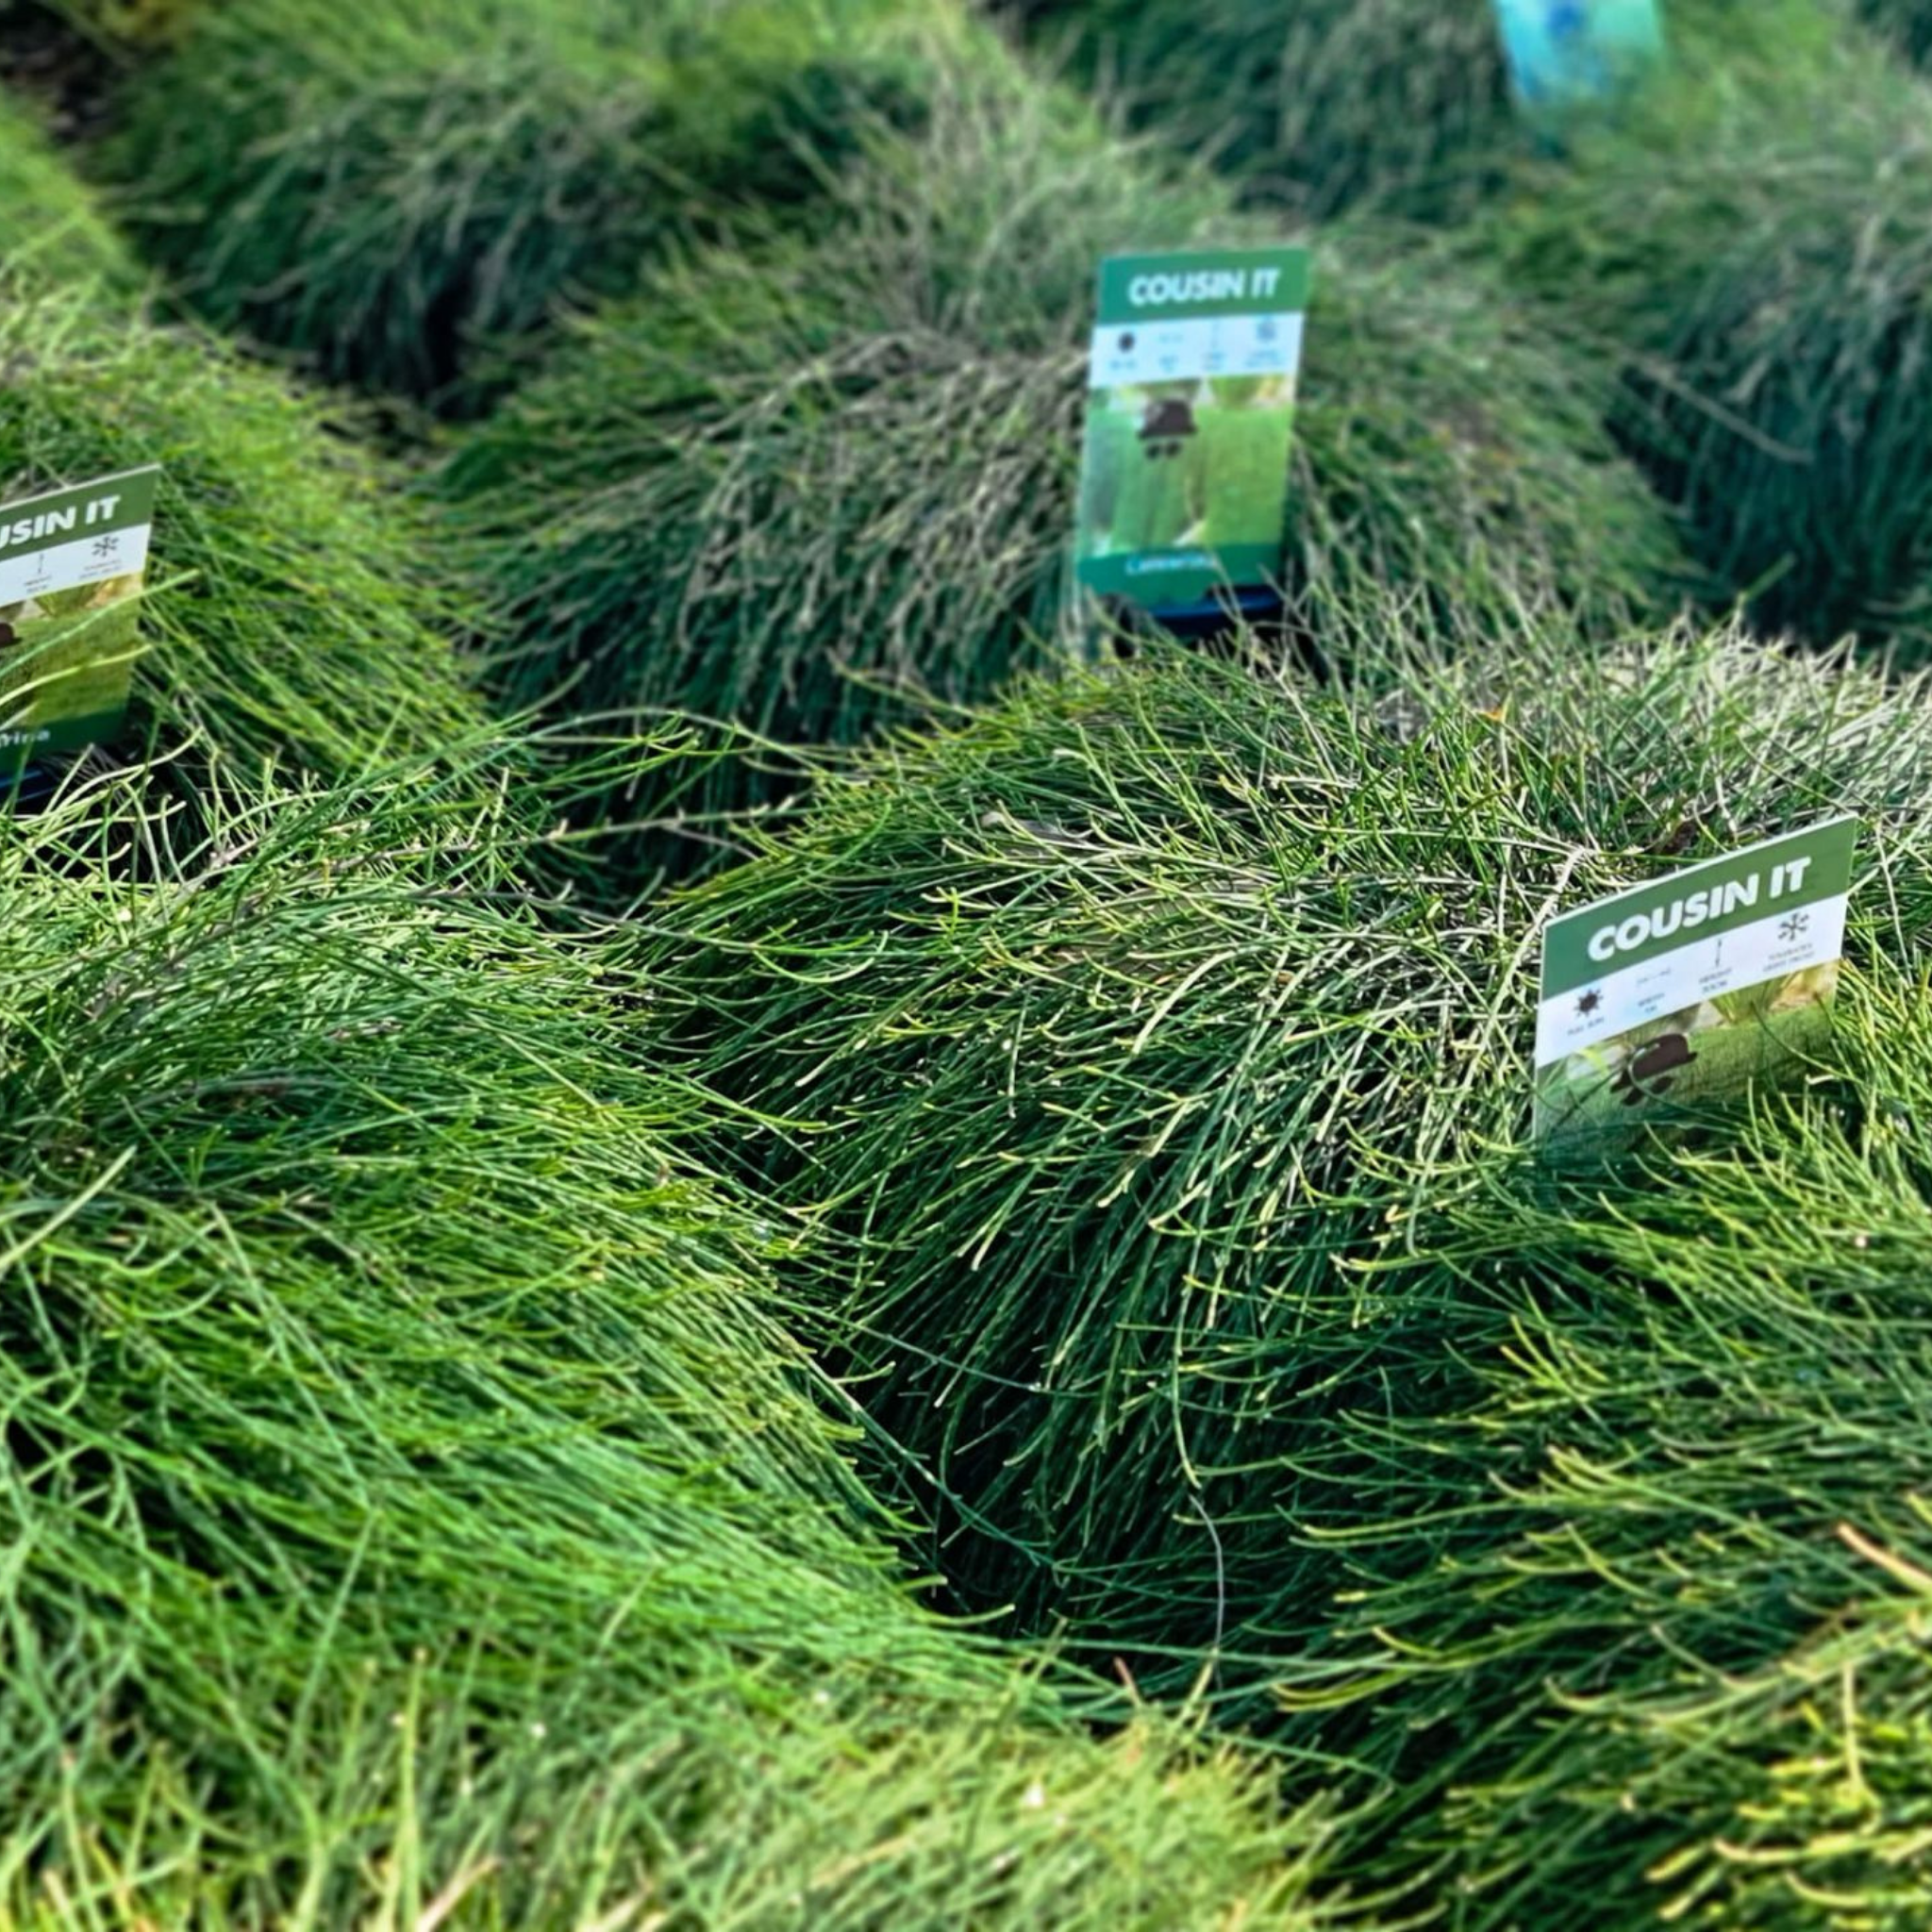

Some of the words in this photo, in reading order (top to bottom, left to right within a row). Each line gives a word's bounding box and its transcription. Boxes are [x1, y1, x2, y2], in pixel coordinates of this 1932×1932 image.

[1129, 269, 1245, 307] COUSIN
[1252, 266, 1281, 298] IT
[86, 494, 121, 525] IT
[1588, 873, 1759, 961] COUSIN
[1770, 857, 1811, 898] IT
